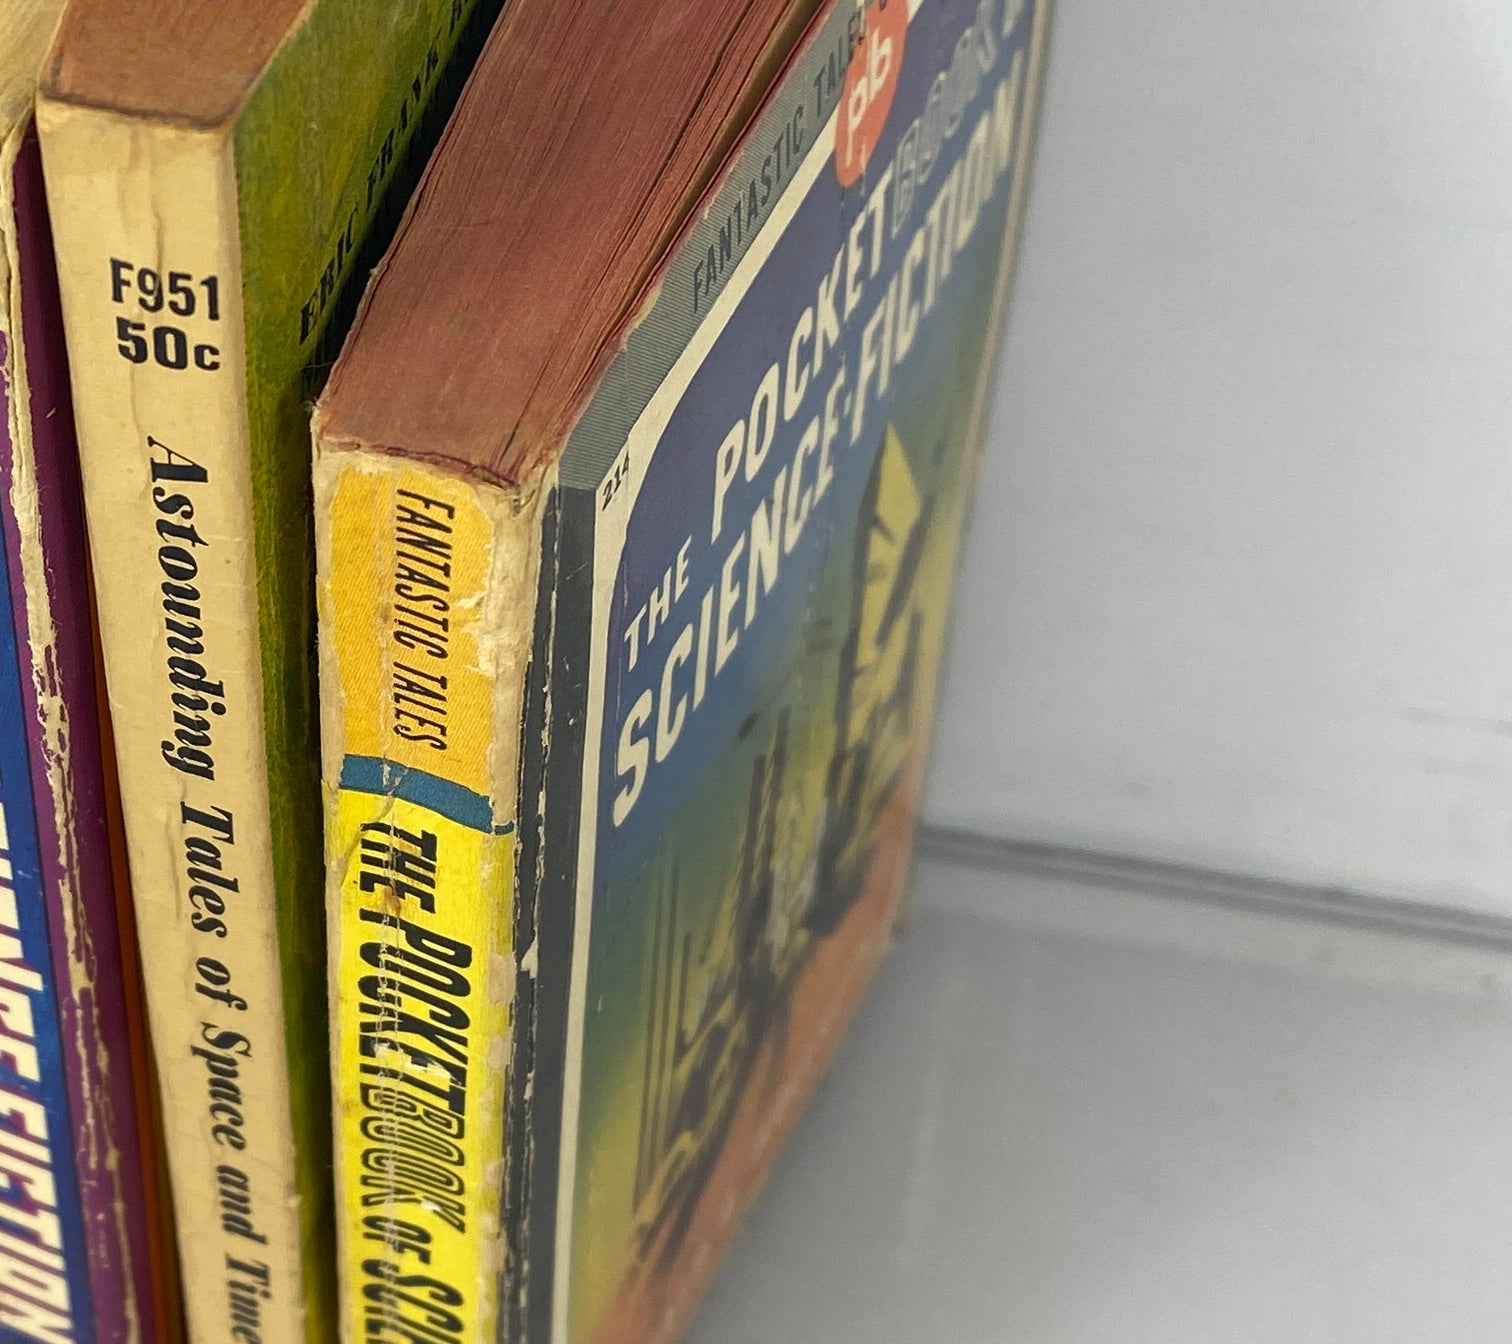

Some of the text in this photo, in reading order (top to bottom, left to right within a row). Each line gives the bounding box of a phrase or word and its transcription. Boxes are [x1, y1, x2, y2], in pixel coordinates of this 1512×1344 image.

[846, 27, 894, 169] pb
[693, 102, 806, 313] FANTASTIC
[109, 256, 220, 322] F951
[601, 450, 630, 513] 214
[147, 434, 228, 782] Astounding
[391, 487, 456, 752] FANTASTIC TALES
[623, 534, 693, 673] THE
[179, 800, 241, 939] Tales
[358, 821, 439, 915] THE
[194, 956, 249, 1012] of
[190, 1021, 253, 1152] Space
[215, 1163, 270, 1246] and
[361, 1214, 433, 1265] OF
